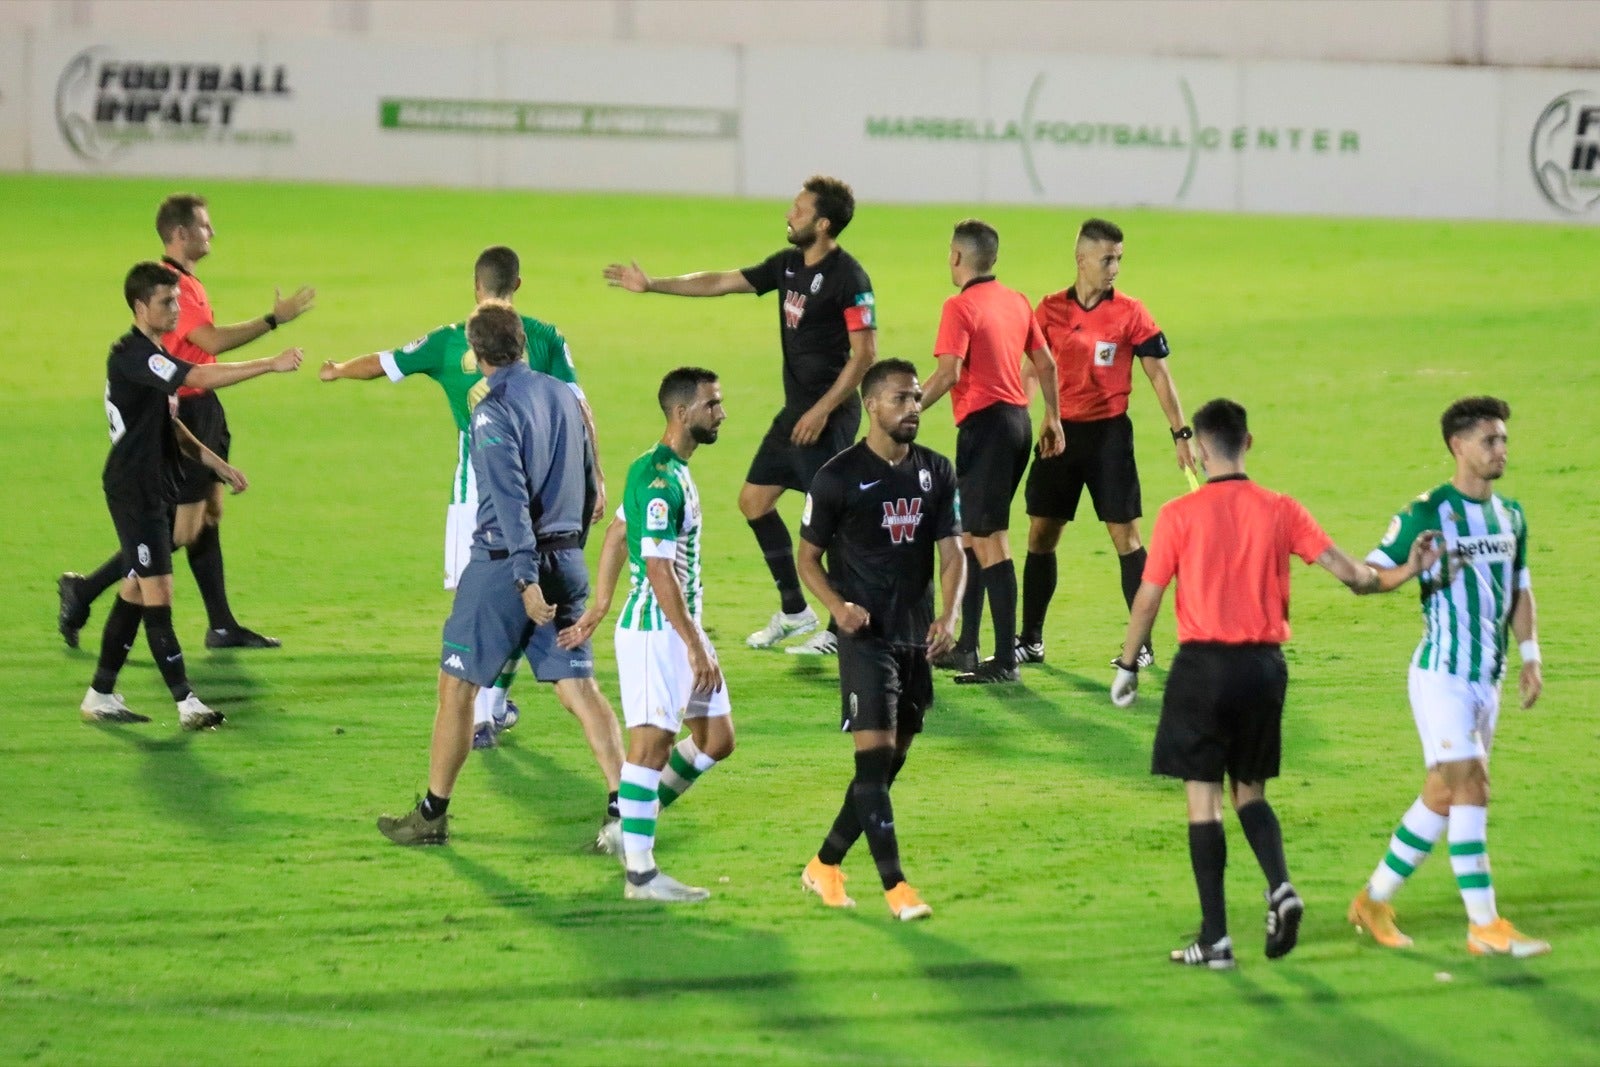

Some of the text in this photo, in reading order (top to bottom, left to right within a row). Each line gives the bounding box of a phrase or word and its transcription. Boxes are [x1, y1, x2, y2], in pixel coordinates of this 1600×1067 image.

[99, 62, 291, 94] FOOTBALL
[95, 96, 237, 125] IMPACT
[864, 115, 1022, 142] MARBELLA
[1198, 126, 1359, 152] CENTER
